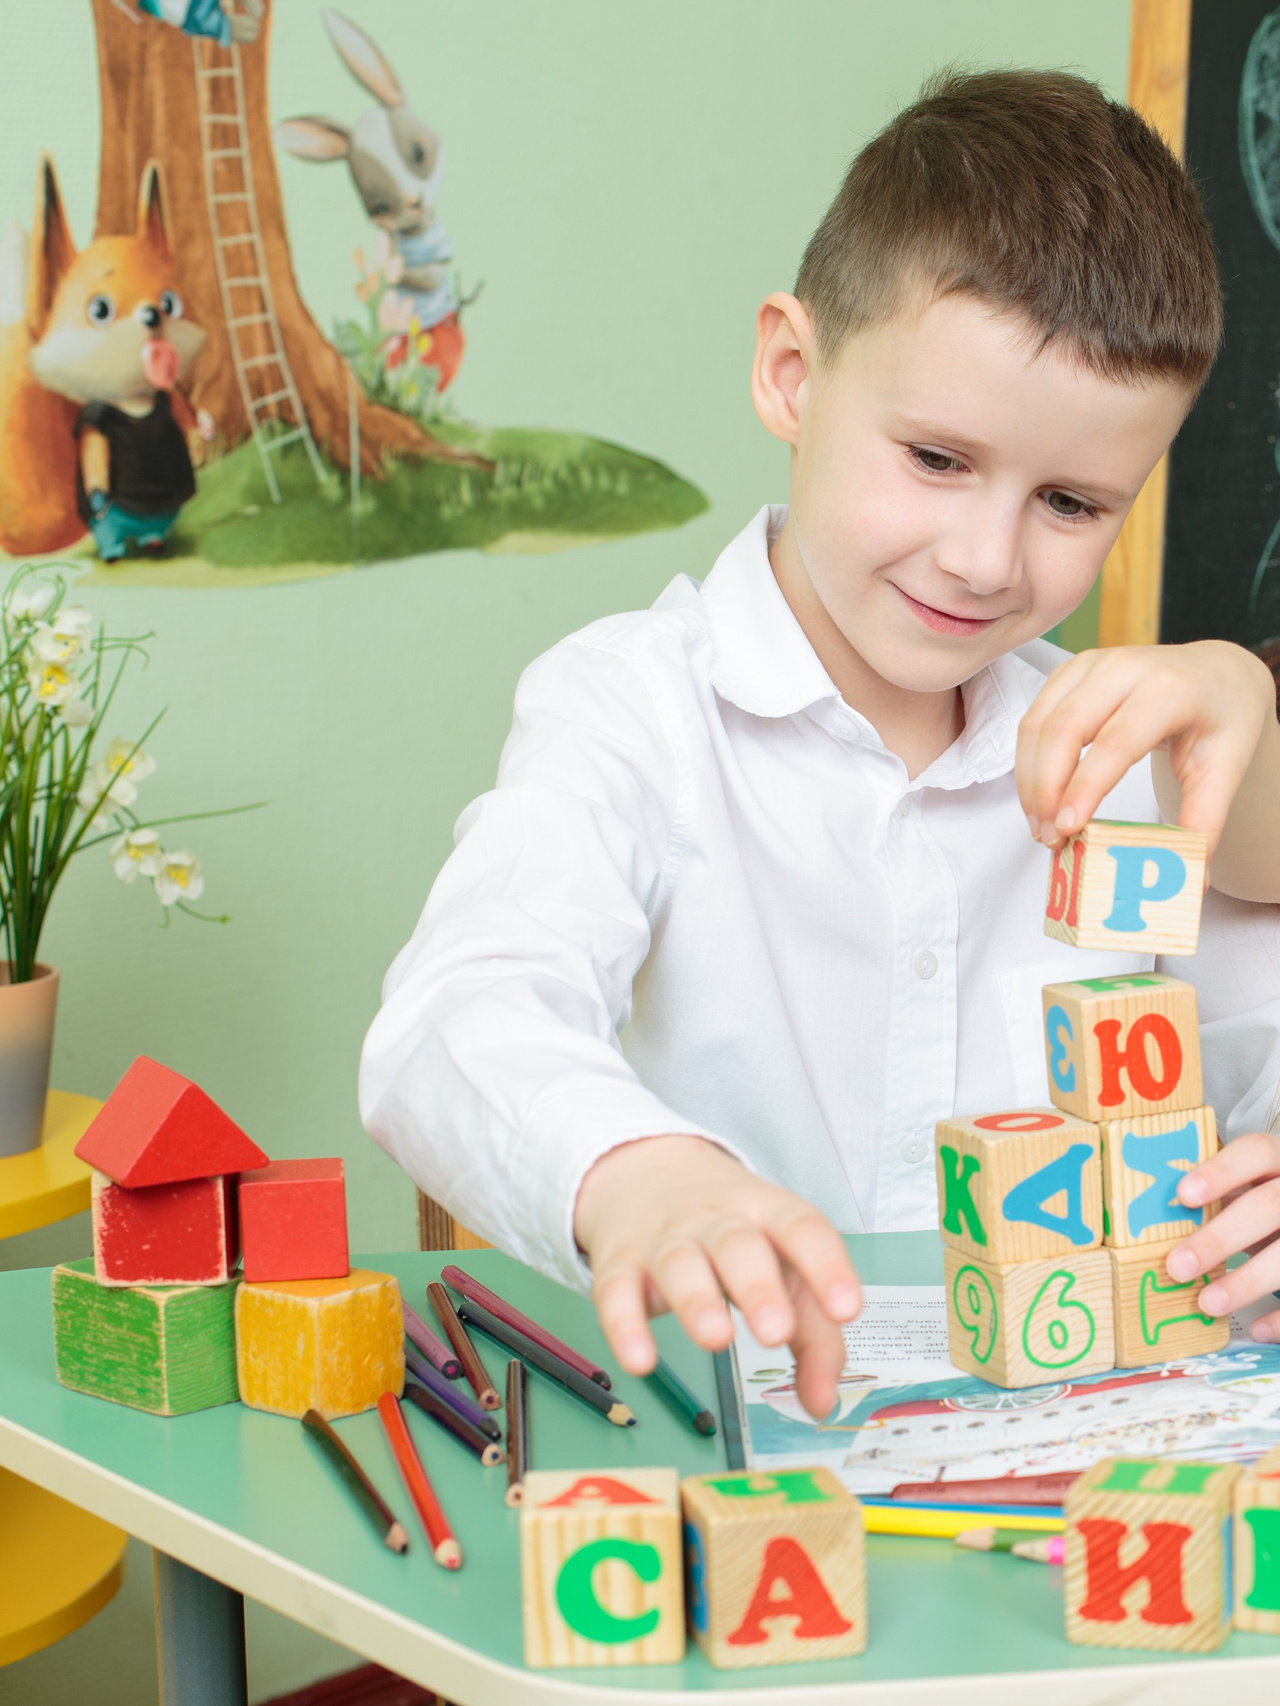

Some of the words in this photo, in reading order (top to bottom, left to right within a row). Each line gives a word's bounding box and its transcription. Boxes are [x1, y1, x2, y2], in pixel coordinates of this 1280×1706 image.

[1102, 845, 1187, 932] Р
[1093, 1012, 1183, 1107] Ю
[940, 1144, 988, 1247] К
[535, 1476, 667, 1509] А
[556, 1536, 663, 1645] С
[725, 1535, 854, 1646] А
[1074, 1516, 1195, 1627] И
